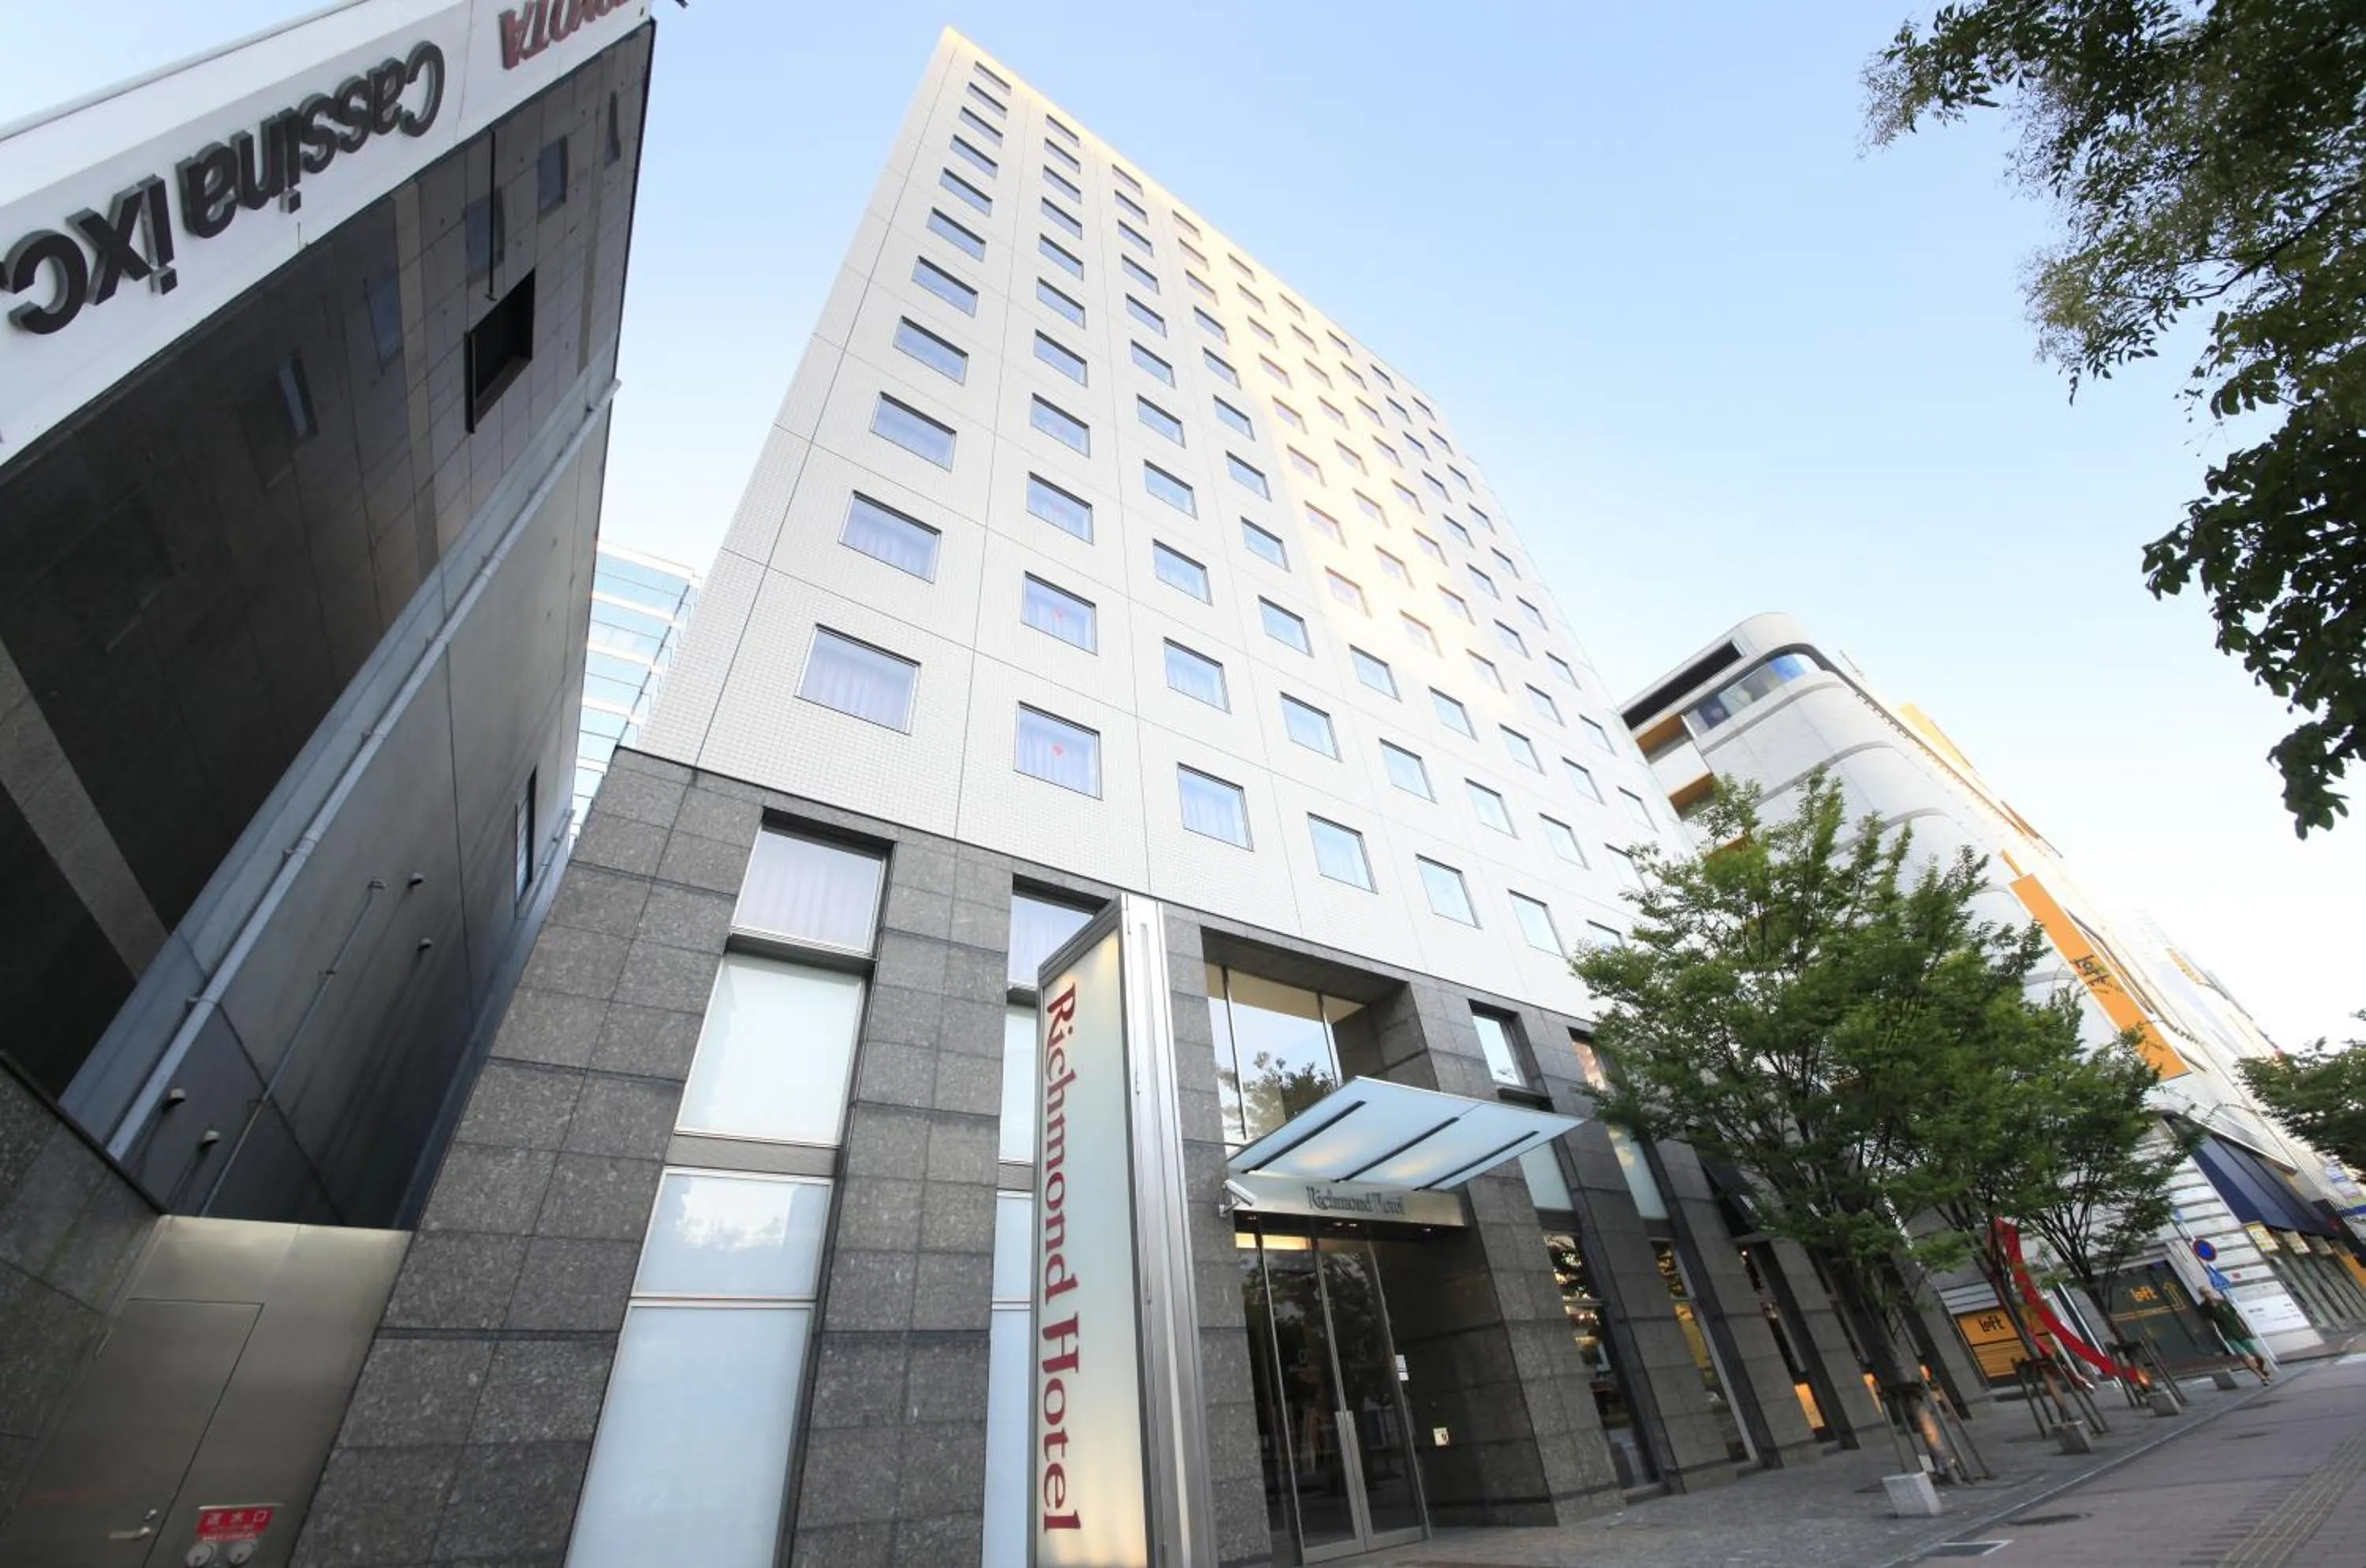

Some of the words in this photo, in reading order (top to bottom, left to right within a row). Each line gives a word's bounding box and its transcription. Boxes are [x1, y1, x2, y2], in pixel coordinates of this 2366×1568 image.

[175, 41, 446, 238] Cassina
[1044, 980, 1079, 1307] Richmond
[1305, 1185, 1371, 1212] Richmond
[1042, 1311, 1083, 1533] Hotel
